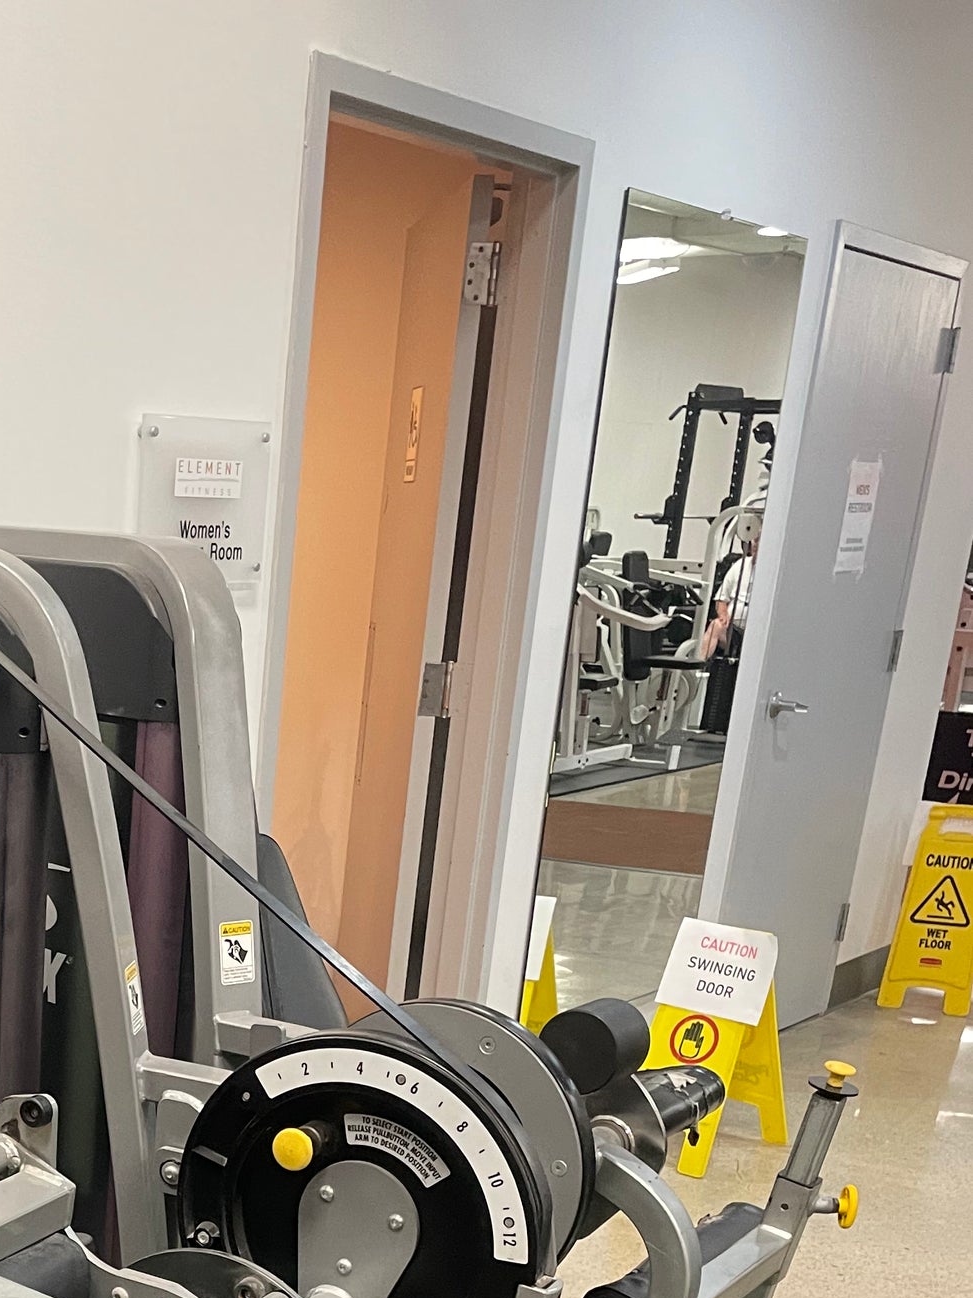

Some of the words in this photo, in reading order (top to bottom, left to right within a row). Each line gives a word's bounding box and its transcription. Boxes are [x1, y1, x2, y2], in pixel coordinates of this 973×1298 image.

[179, 460, 241, 476] ELEMENT
[185, 486, 231, 496] FITNESS
[180, 520, 231, 539] Women's
[210, 543, 242, 560] Room
[927, 928, 948, 939] WET
[701, 936, 757, 959] CAUTION
[919, 939, 951, 950] FLOOR
[687, 956, 755, 982] SWINGING
[696, 980, 734, 998] DOOR
[362, 1116, 370, 1124] TO
[372, 1118, 392, 1129] SELECT
[393, 1125, 411, 1140] START
[411, 1136, 438, 1162] POSITION
[301, 1062, 309, 1076] 2
[356, 1061, 364, 1075] 4
[411, 1081, 420, 1095] 6
[456, 1120, 469, 1133] 8
[488, 1172, 503, 1189] 10
[503, 1233, 516, 1248] 12
[348, 1125, 371, 1133] RELEASE
[411, 1146, 426, 1163] MOVE
[426, 1160, 441, 1180] INPUT
[371, 1136, 378, 1144] TO
[380, 1139, 405, 1156] DESIRED
[404, 1153, 430, 1179] POSITION
